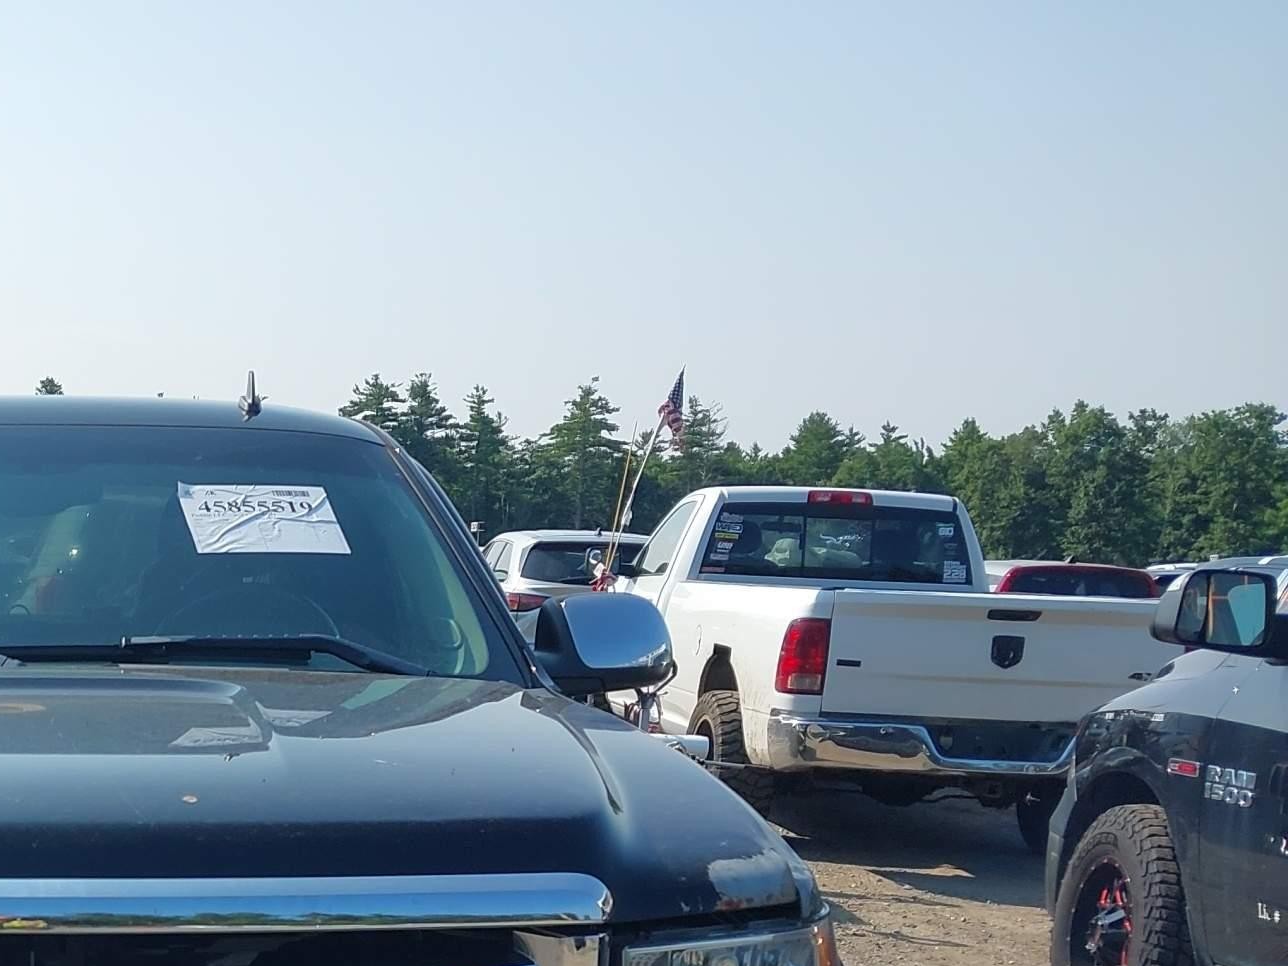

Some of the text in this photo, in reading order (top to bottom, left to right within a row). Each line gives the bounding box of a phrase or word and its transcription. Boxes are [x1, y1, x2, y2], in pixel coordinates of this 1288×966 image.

[198, 500, 313, 514] 45855519
[1207, 764, 1257, 789] RAM
[1204, 782, 1254, 808] 1500
